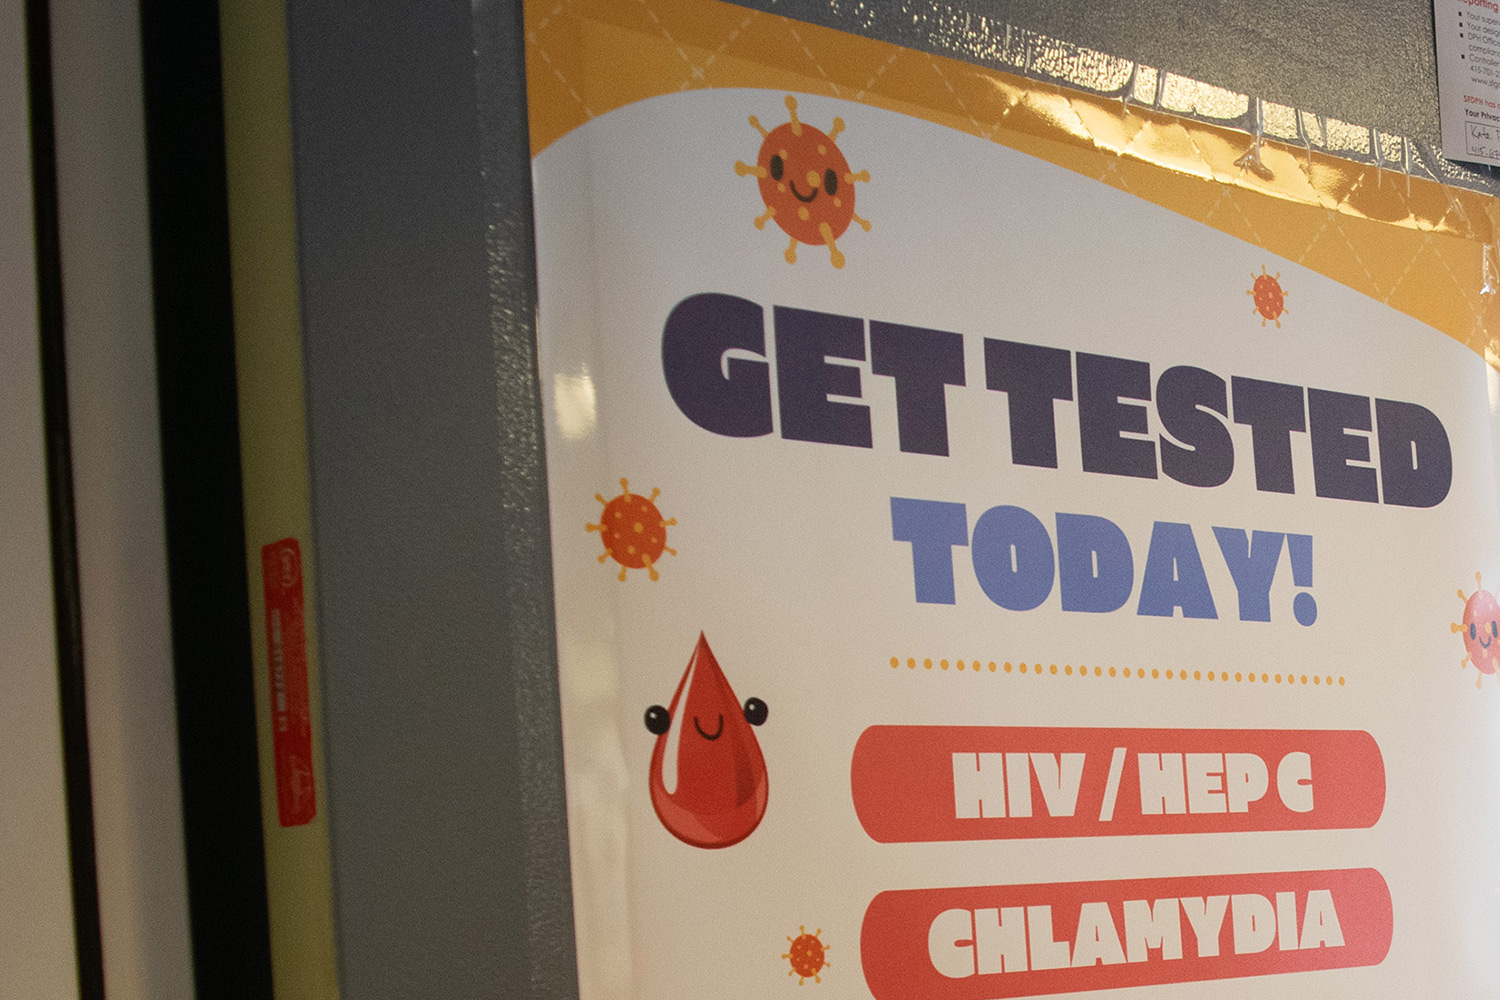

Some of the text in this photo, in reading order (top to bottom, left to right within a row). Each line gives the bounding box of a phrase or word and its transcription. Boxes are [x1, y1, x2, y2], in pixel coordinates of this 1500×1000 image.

[1457, 0, 1499, 14] eporting
[1463, 94, 1484, 106] SFDPH
[1485, 99, 1496, 109] has
[1464, 108, 1479, 118] Your
[660, 292, 1454, 509] GET TESTED
[888, 496, 1318, 627] TODAY!
[951, 747, 1314, 821] HIV / HEP C
[927, 889, 1346, 979] CHLAMYDIA
